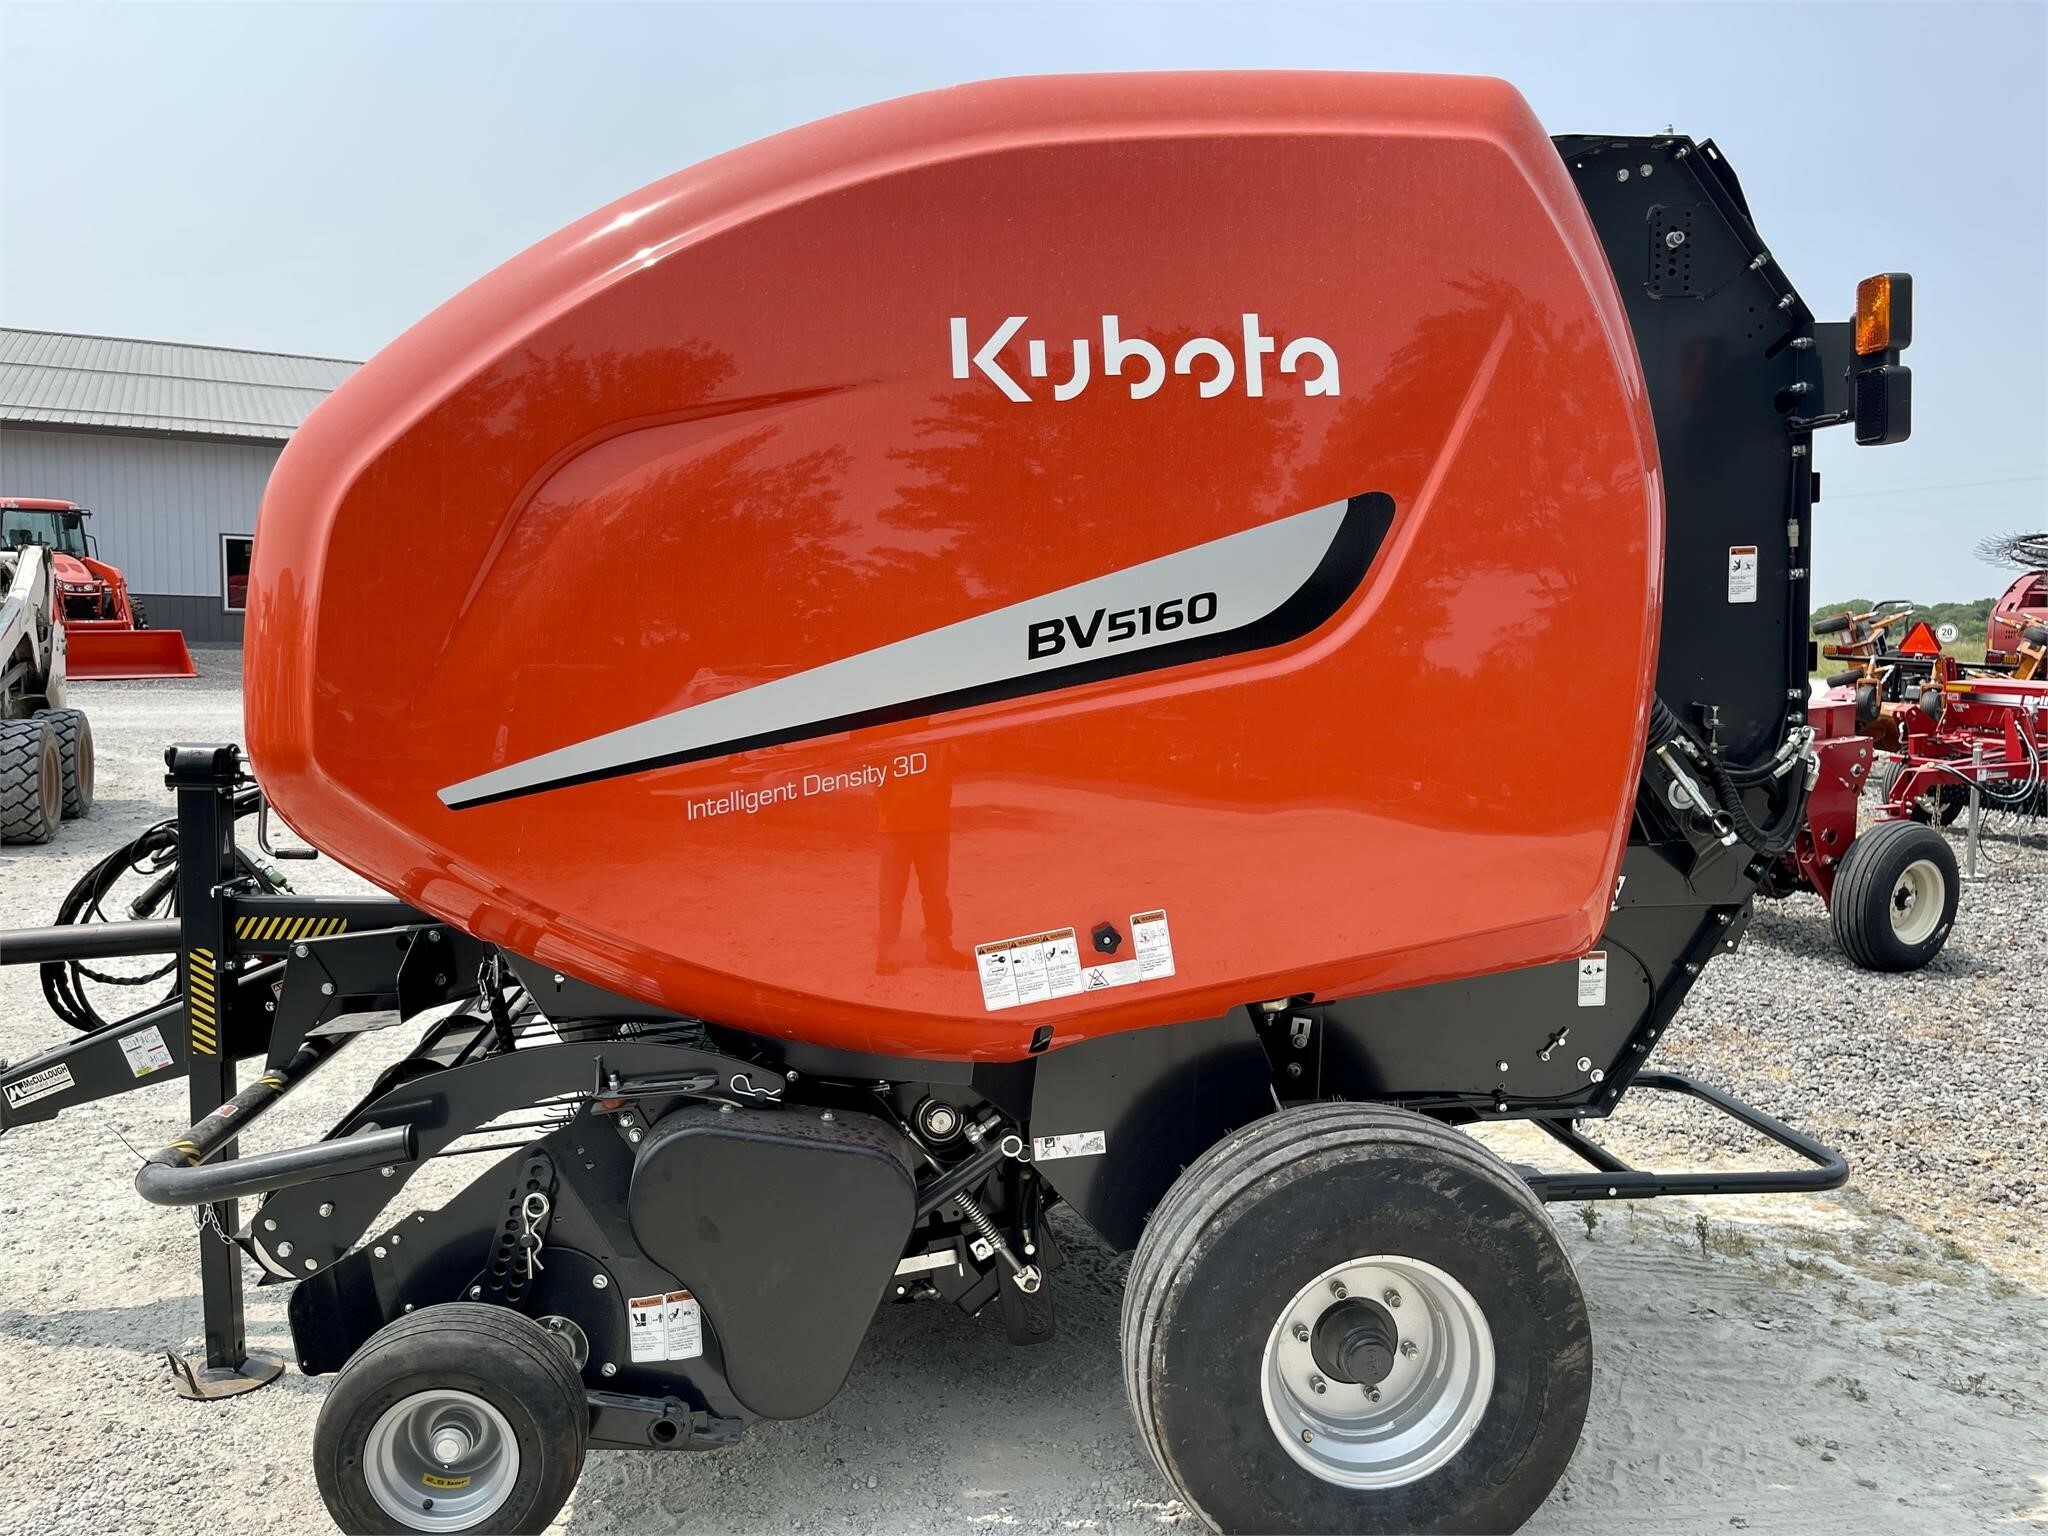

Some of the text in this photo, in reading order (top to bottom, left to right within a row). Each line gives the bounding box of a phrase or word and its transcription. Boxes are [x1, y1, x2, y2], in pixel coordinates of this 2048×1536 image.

[950, 313, 1340, 402] Kubota
[1028, 591, 1218, 660] BV5160
[1942, 628, 1953, 636] 20
[687, 752, 927, 820] Intelligent Density 3D
[1018, 937, 1040, 946] WARNING
[1050, 931, 1072, 939] WARNING
[985, 944, 1008, 952] WARNING
[22, 1065, 68, 1088] McCULLOUGH
